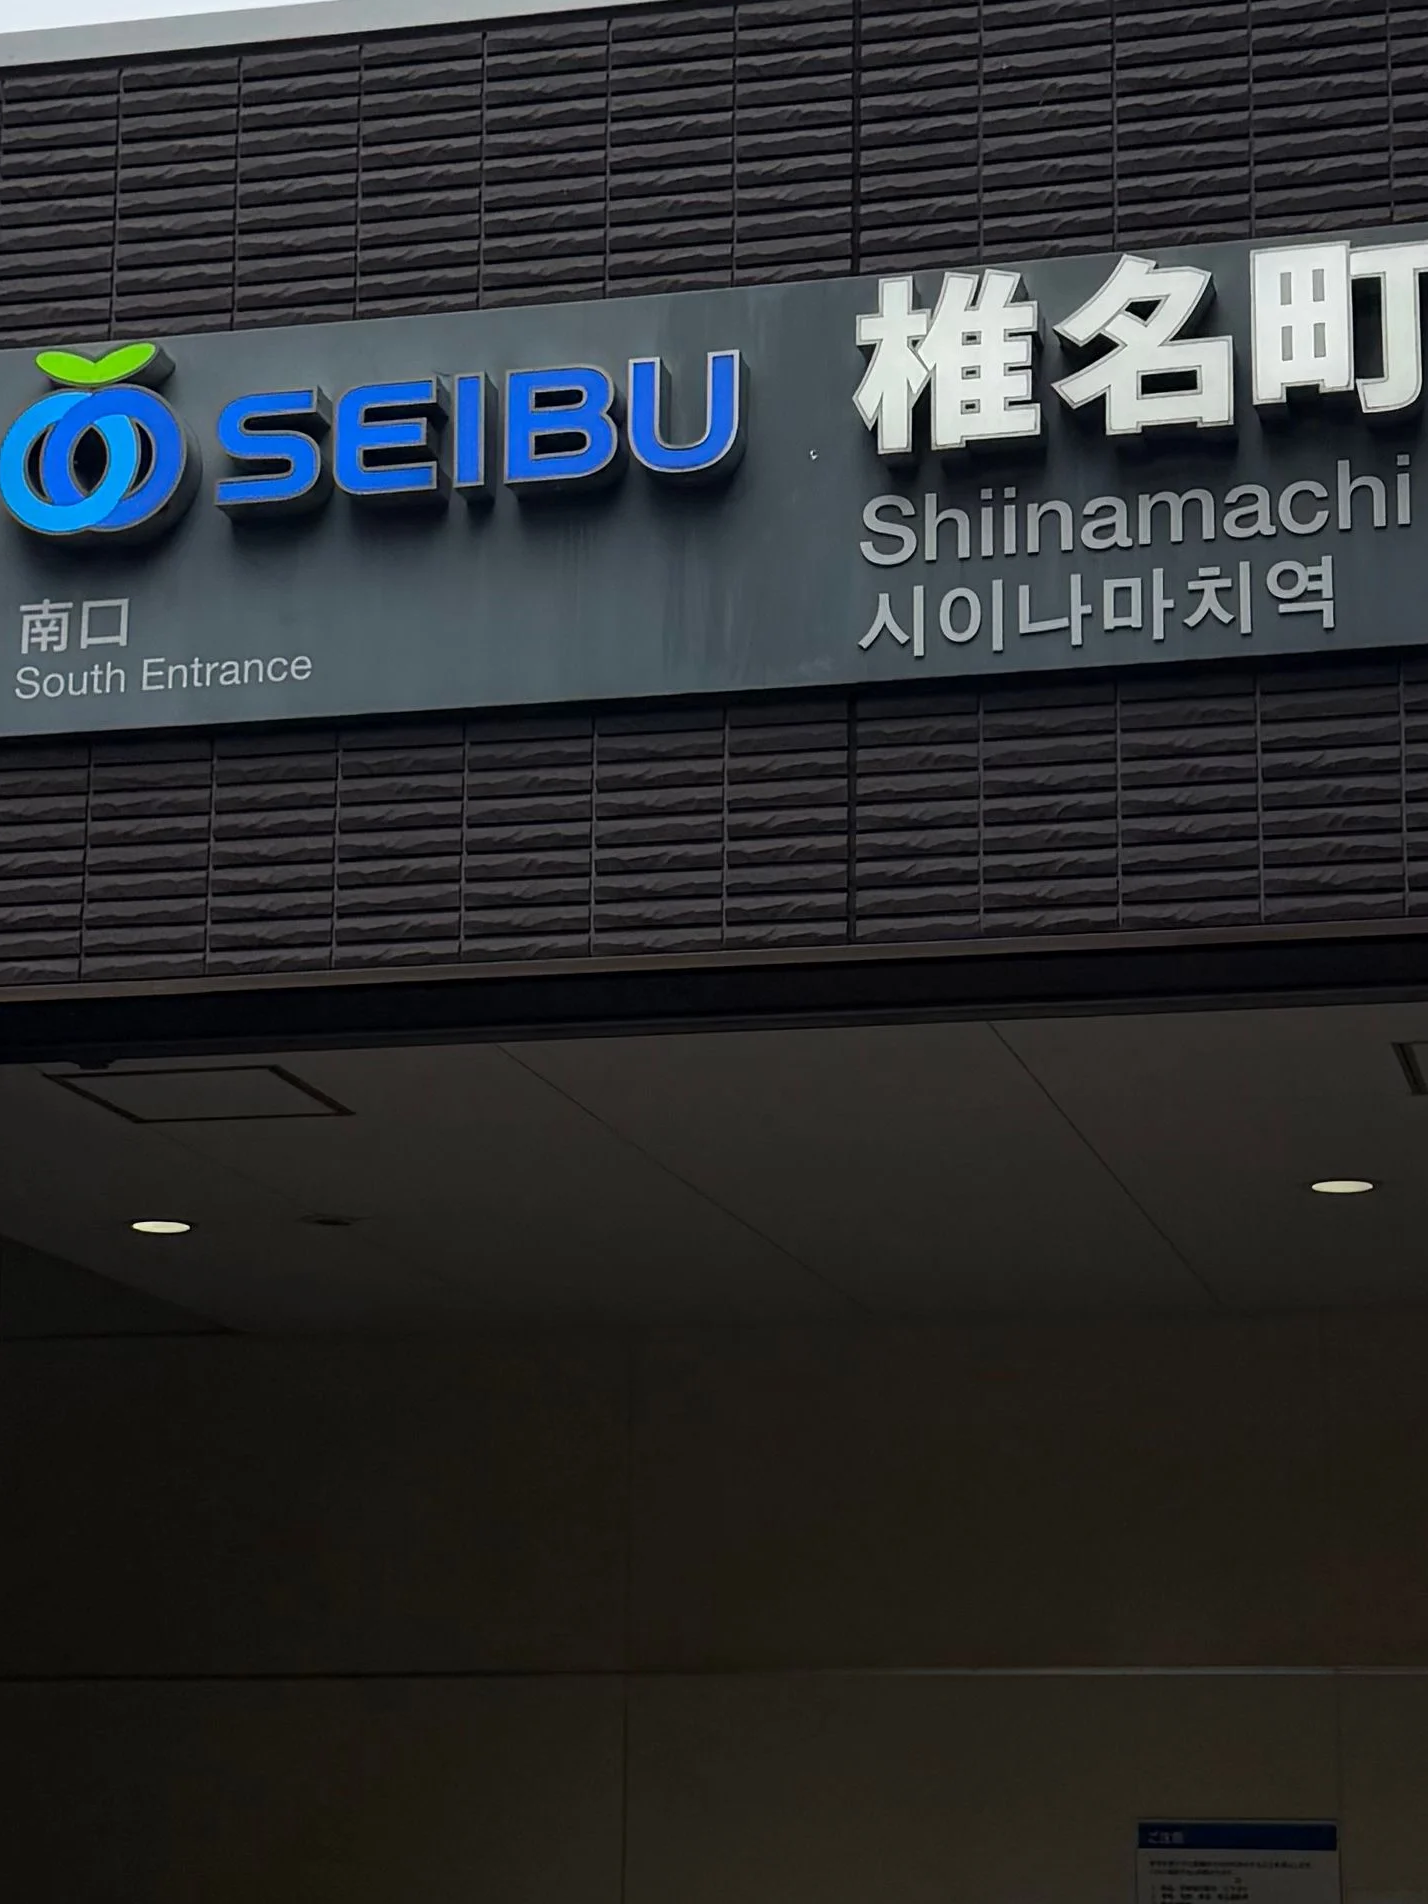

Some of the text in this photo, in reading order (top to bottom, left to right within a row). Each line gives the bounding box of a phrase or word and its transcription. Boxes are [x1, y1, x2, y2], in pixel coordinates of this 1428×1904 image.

[215, 349, 742, 509] SEIBU
[859, 453, 1412, 567] Shiinamachi
[19, 598, 130, 654] 南口
[857, 554, 1336, 658] 시이나마치역
[15, 654, 313, 700] South Entrance
